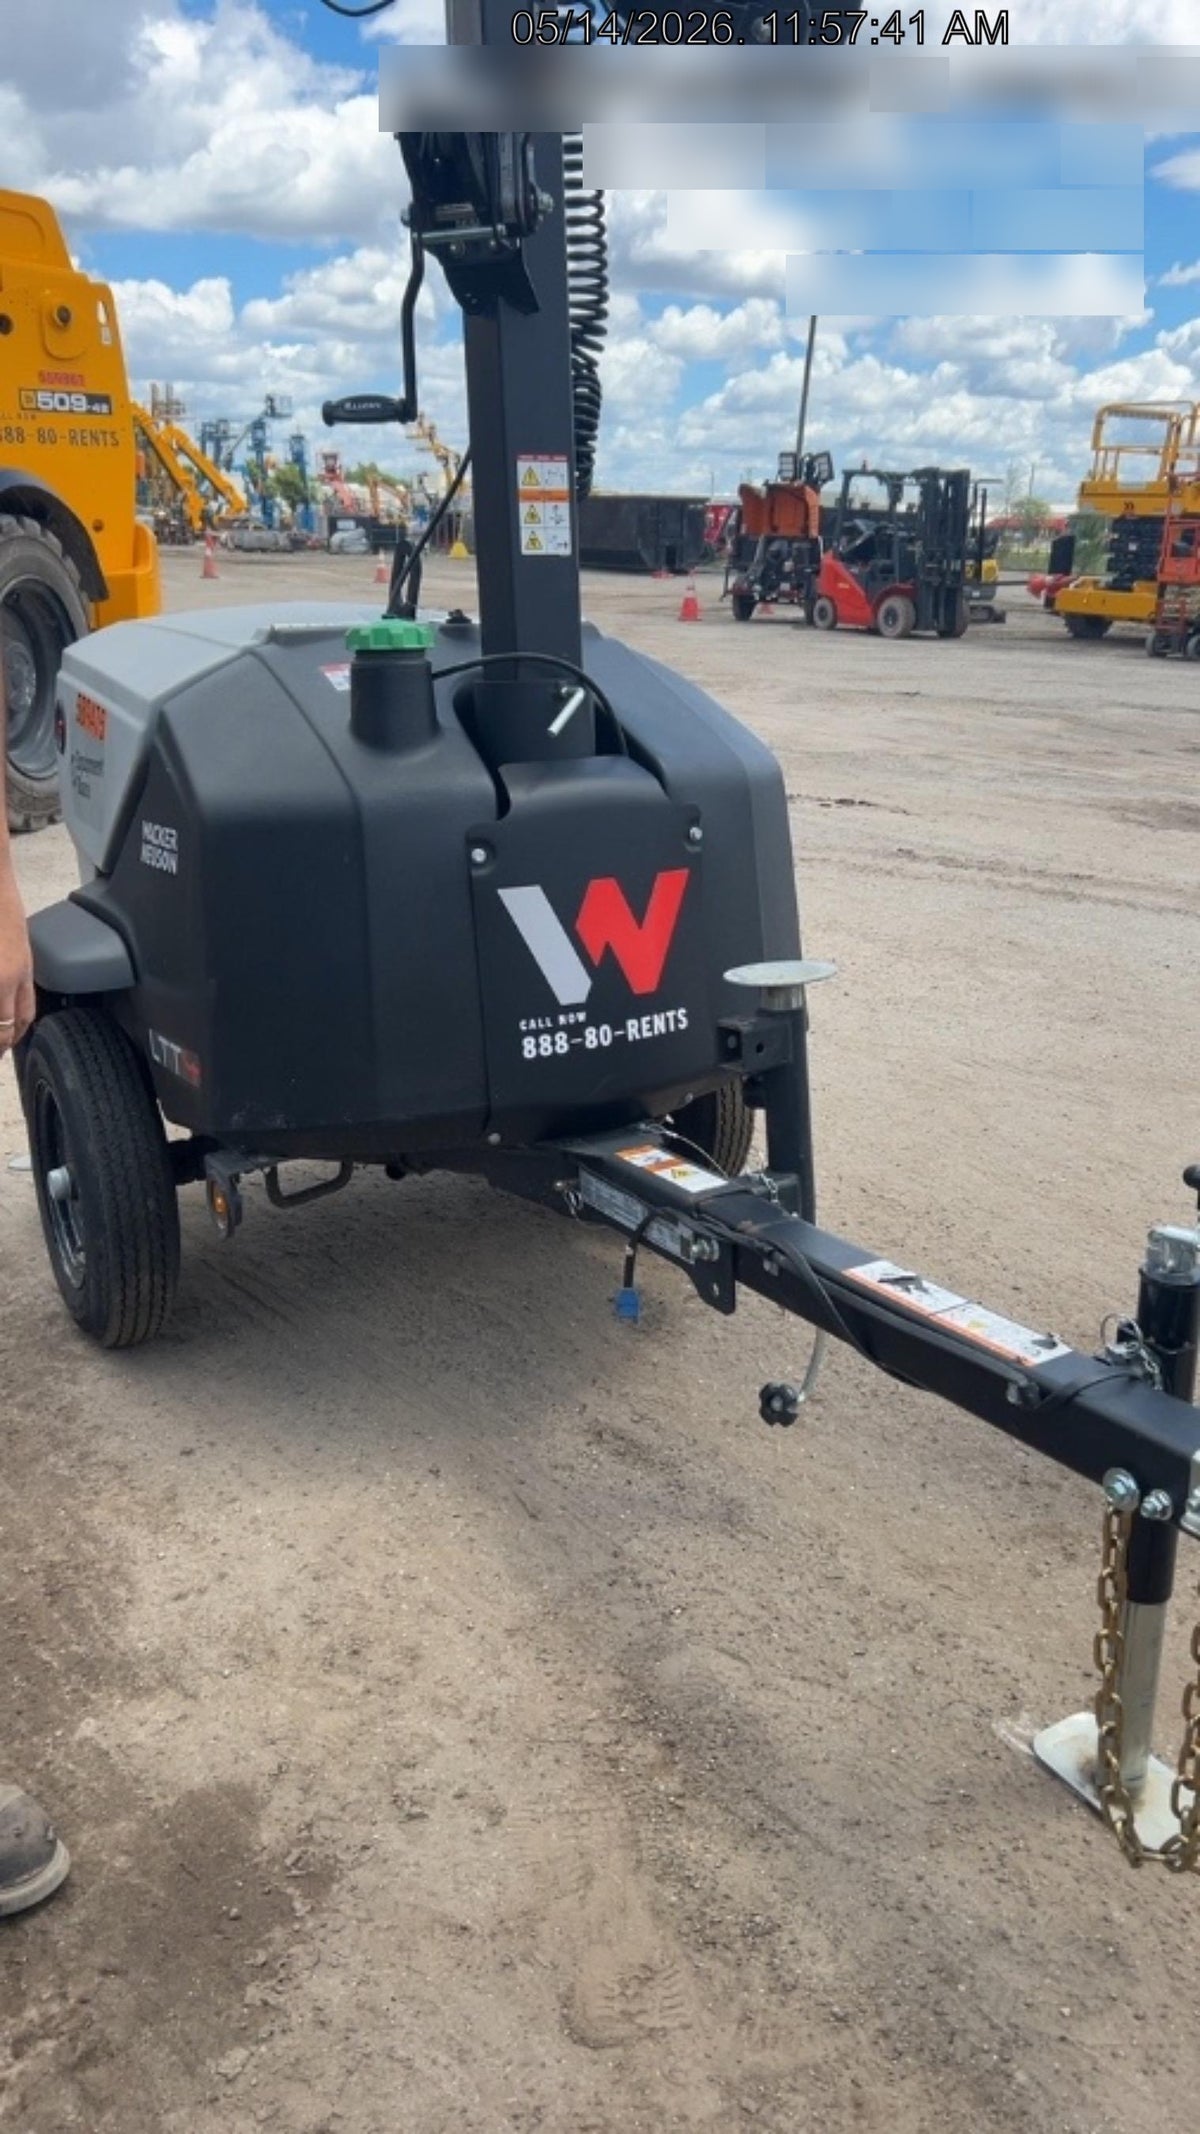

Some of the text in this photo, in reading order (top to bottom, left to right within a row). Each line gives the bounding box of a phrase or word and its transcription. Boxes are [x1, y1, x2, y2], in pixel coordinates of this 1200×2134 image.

[0, 426, 120, 447] 88-80-RENTS
[519, 1011, 587, 1031] CALL NOW
[522, 1007, 689, 1059] 888-80-RENTS
